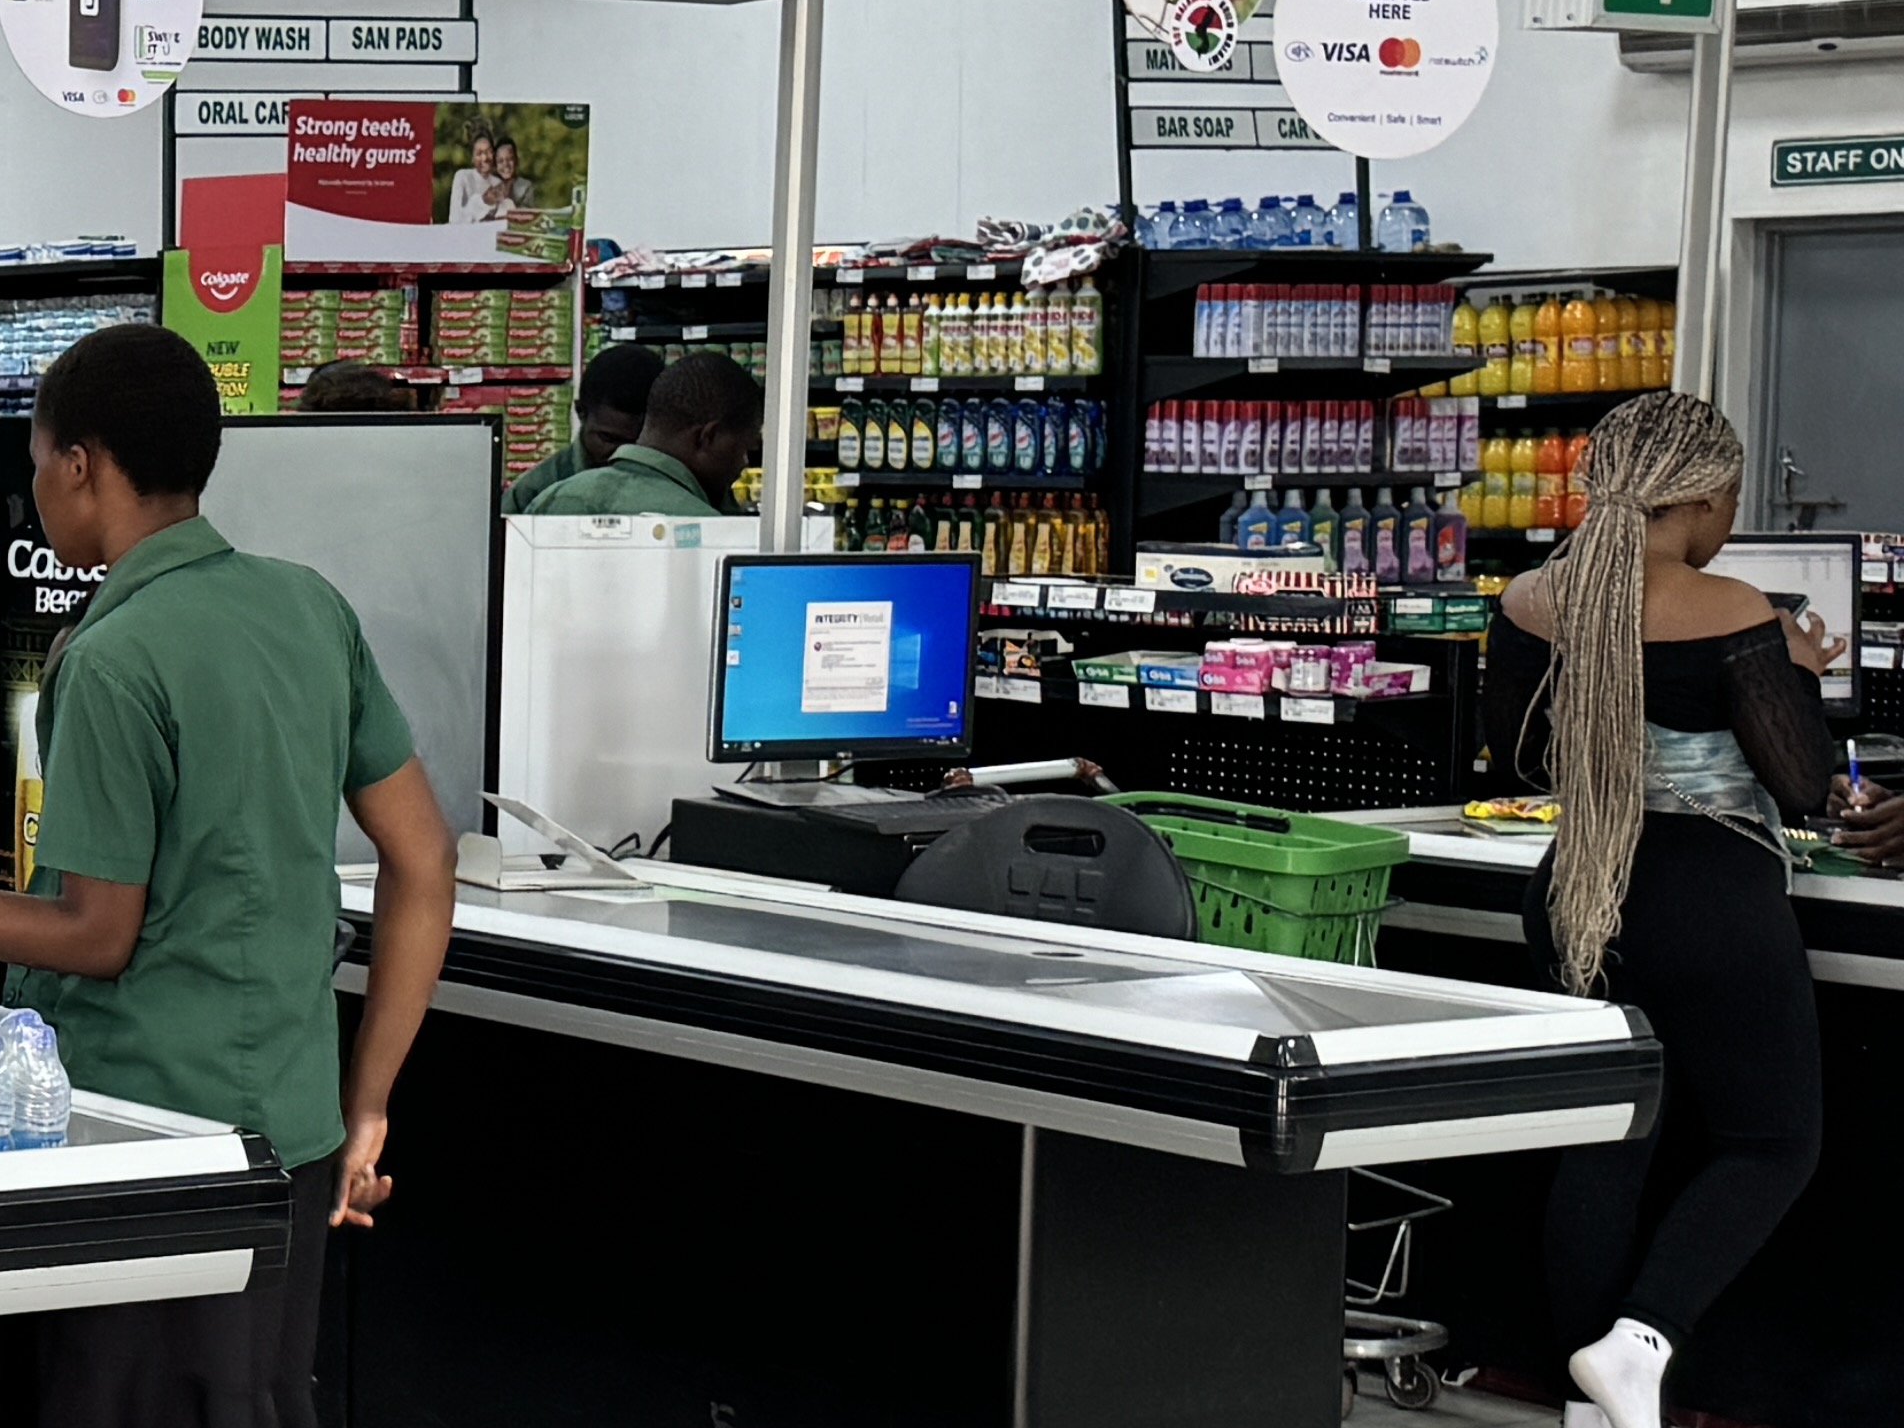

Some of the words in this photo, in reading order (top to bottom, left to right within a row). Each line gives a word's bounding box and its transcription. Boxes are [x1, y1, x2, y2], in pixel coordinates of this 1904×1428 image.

[1369, 4, 1411, 20] HERE
[198, 26, 249, 50] BODY
[256, 27, 310, 50] WASH
[352, 27, 389, 50] SAN
[396, 28, 442, 50] PADS
[1320, 43, 1370, 62] VISA
[63, 91, 85, 102] VISA
[198, 101, 248, 124] ORAL
[1328, 112, 1375, 123] Convenient
[1386, 114, 1406, 124] Safe
[1417, 115, 1442, 126] Smart
[295, 116, 356, 141] Strong
[362, 118, 415, 140] teeth,
[1157, 116, 1189, 137] BAR
[1193, 117, 1234, 139] SOAP
[1278, 117, 1310, 139] CAR
[294, 143, 362, 169] healthy
[1787, 150, 1863, 173] STAFF
[201, 271, 249, 288] Colgate
[206, 341, 240, 356] NEW
